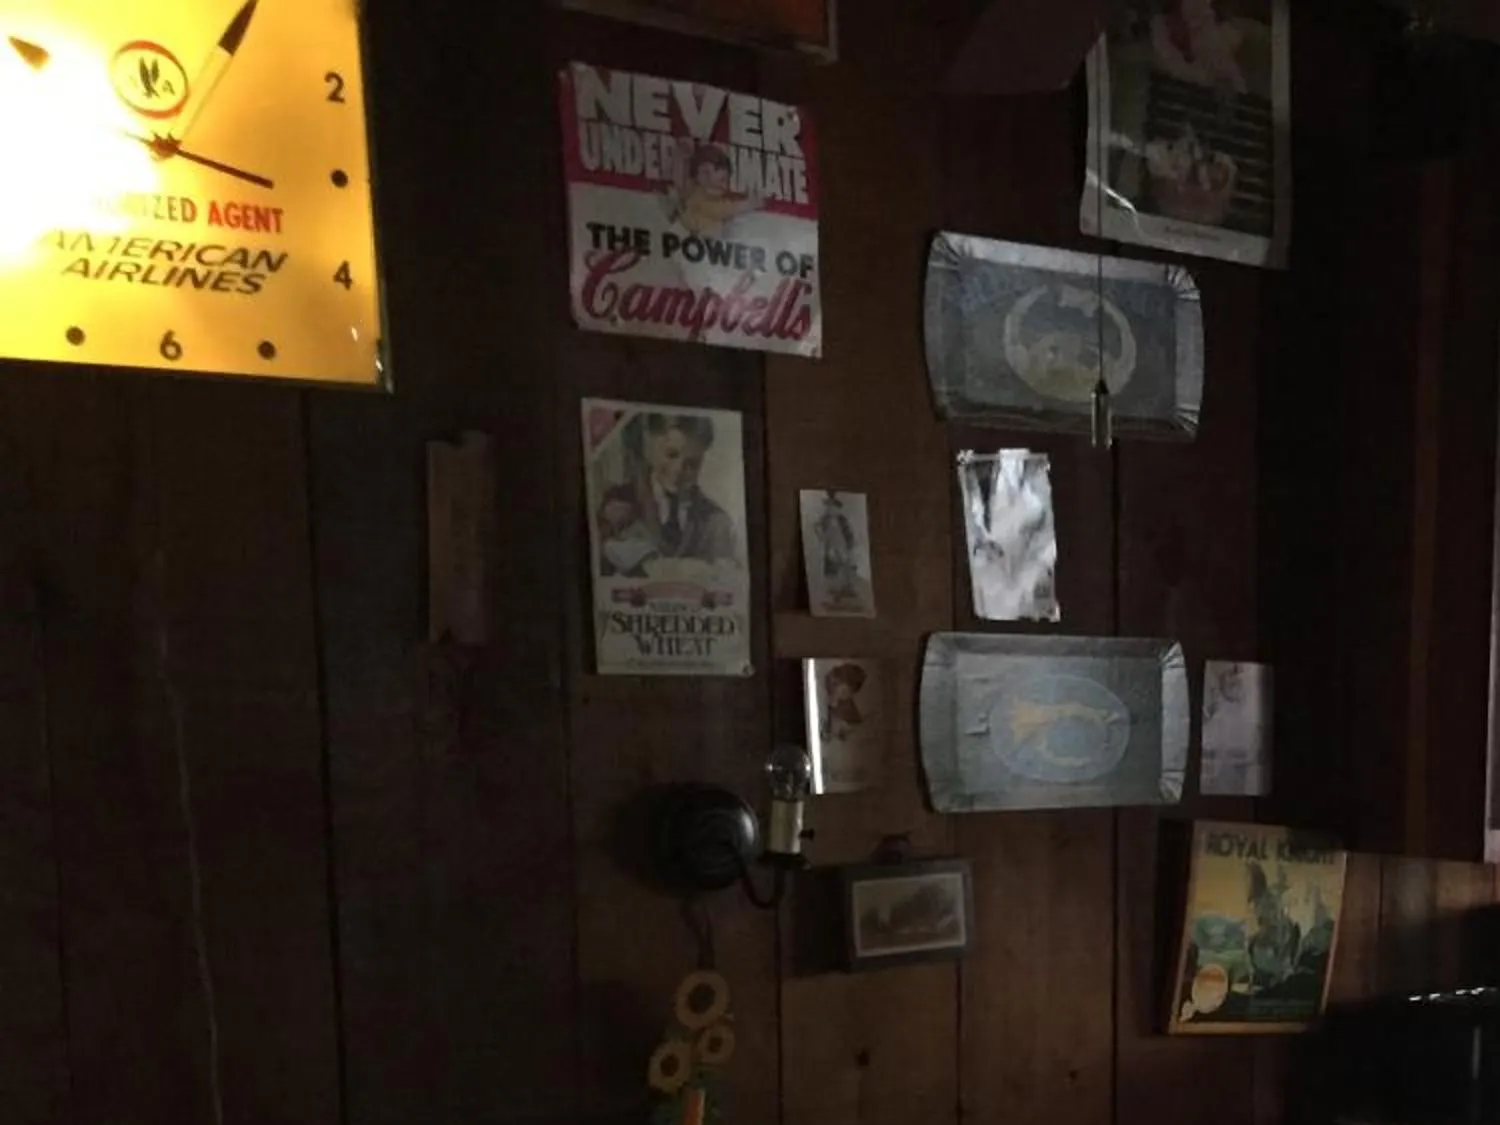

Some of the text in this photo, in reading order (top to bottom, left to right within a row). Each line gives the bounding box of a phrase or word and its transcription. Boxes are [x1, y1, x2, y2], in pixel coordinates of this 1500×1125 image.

[323, 71, 346, 104] 2
[570, 61, 803, 158] NEVER
[206, 200, 285, 234] AGENT
[585, 221, 815, 279] THE POWER OF
[61, 256, 268, 295] AIRLINES
[332, 260, 353, 290] 4
[159, 330, 183, 361] 6
[611, 611, 736, 636] SHREDDED
